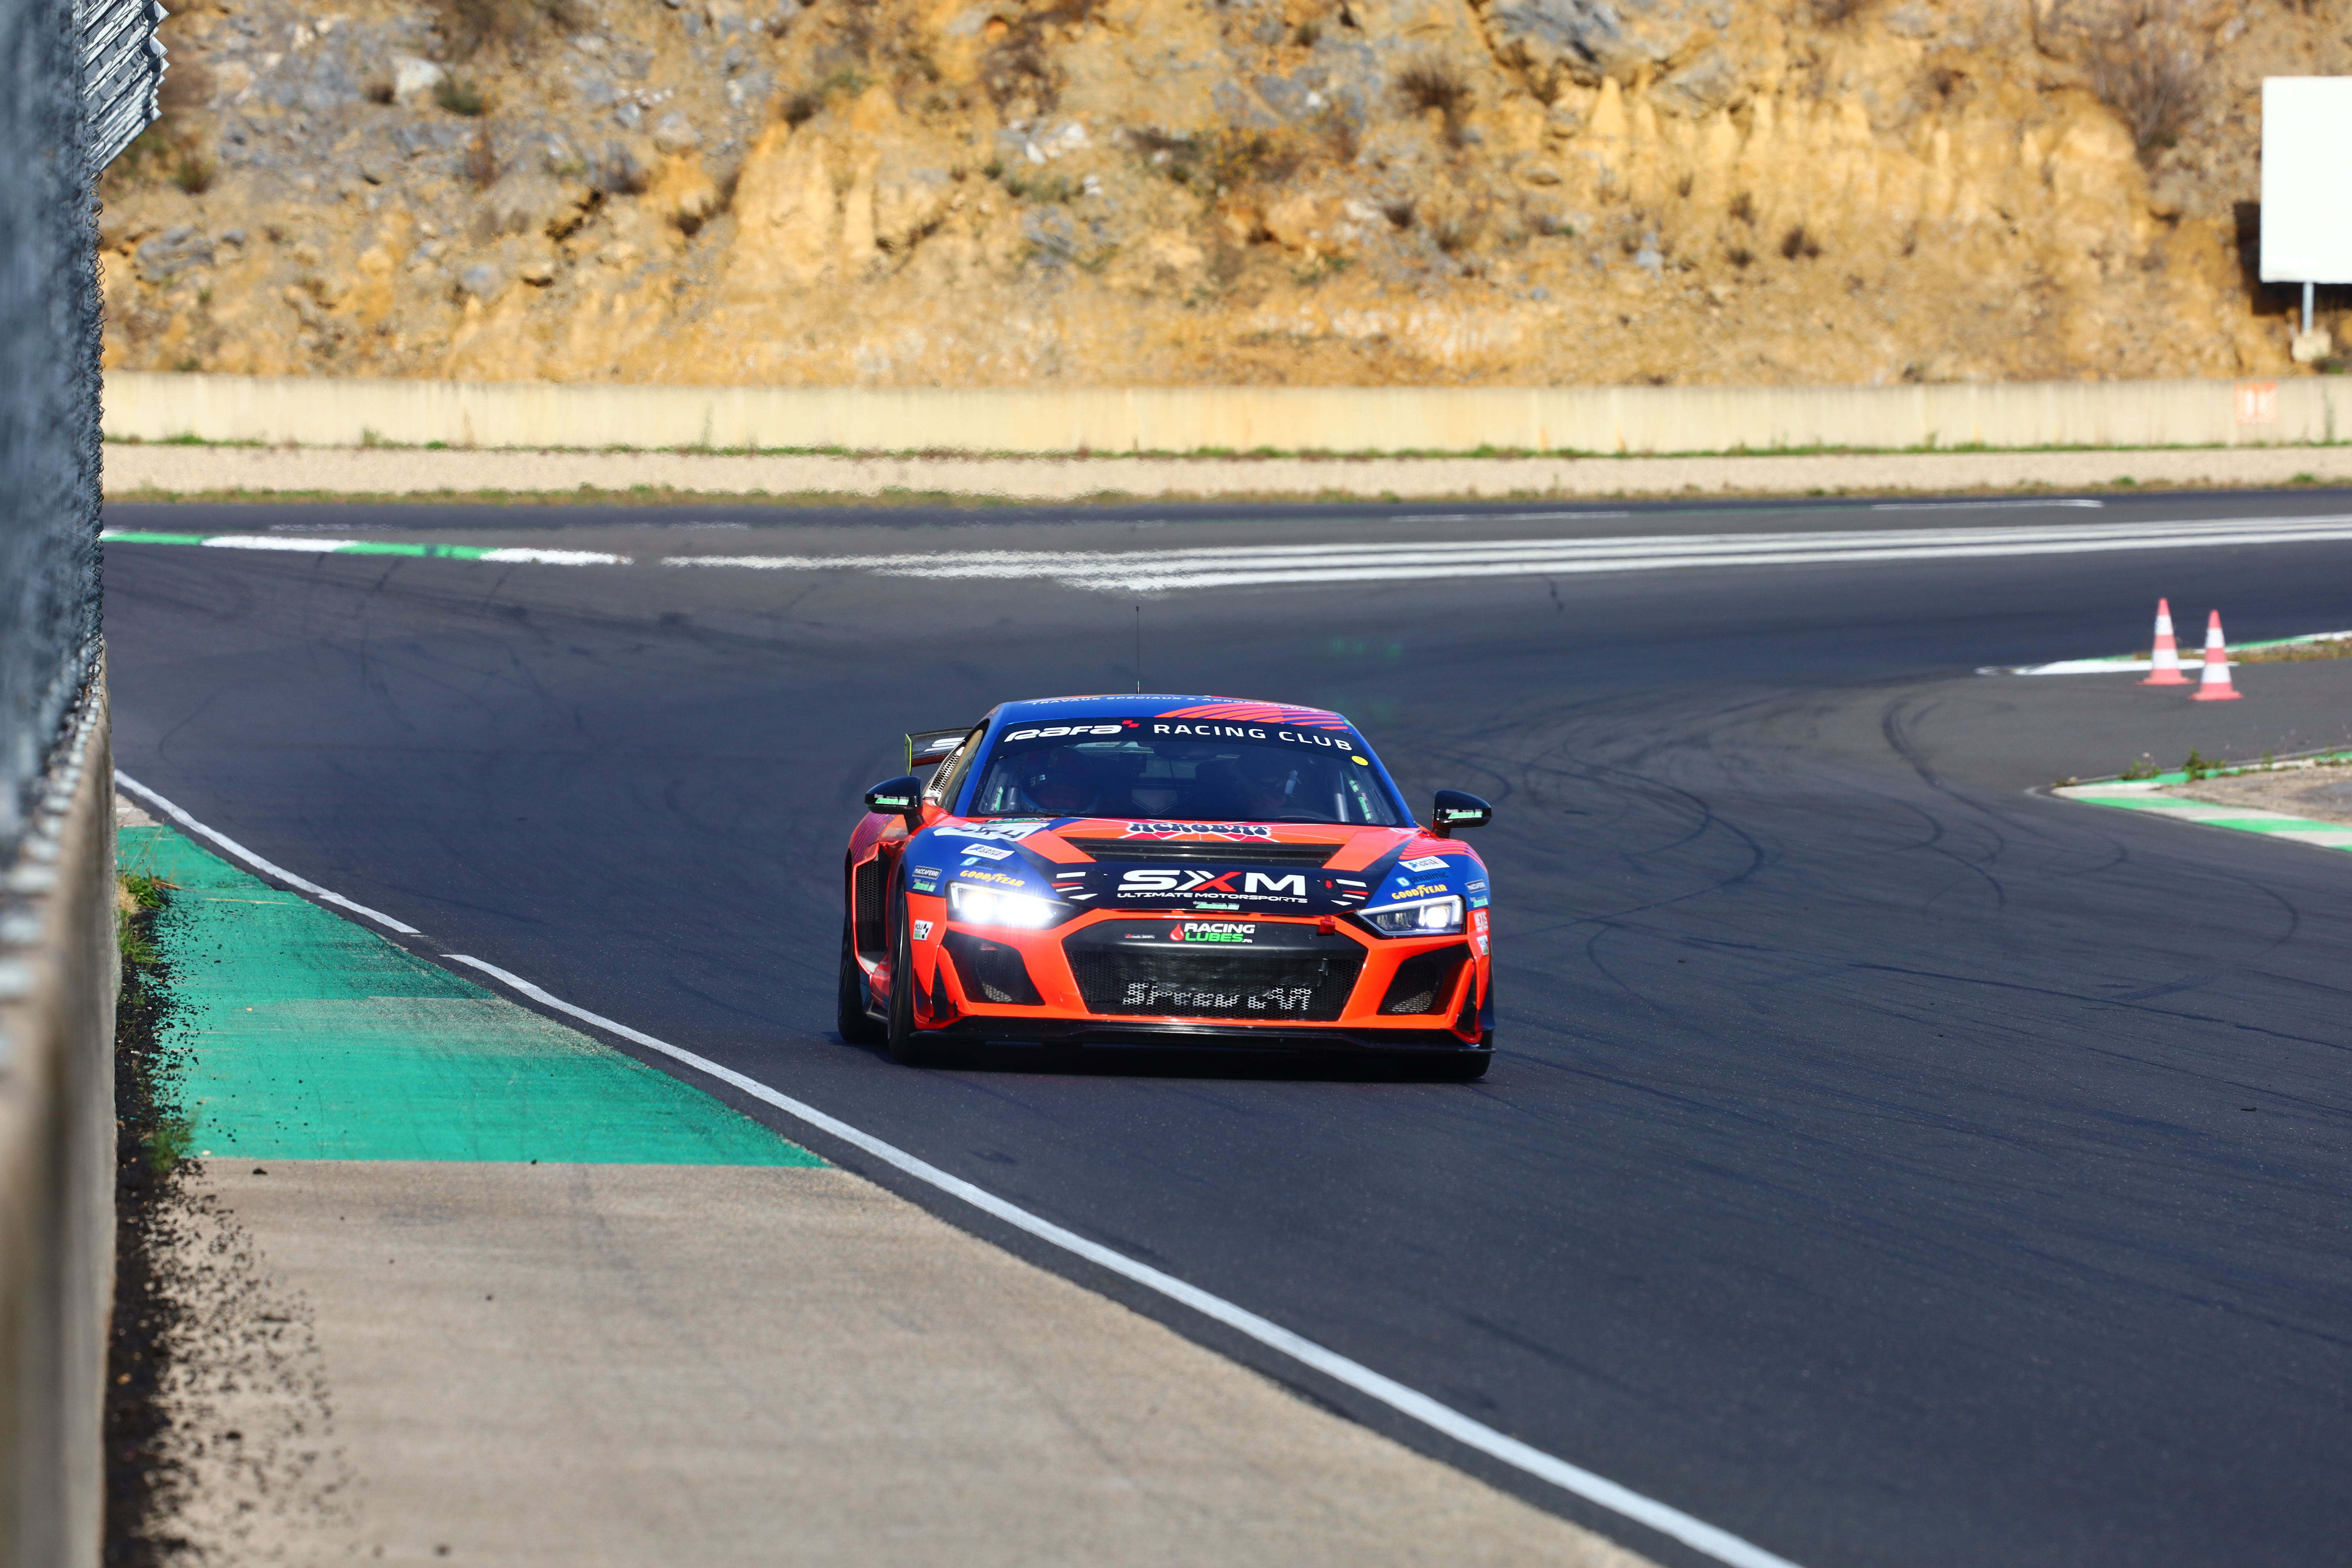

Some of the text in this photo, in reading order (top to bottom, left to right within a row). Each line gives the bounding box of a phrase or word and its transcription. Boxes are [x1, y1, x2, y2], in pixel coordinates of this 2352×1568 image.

[1154, 724, 1266, 739] RACING
[1279, 731, 1352, 751] CLUB
[1127, 822, 1271, 836] ACROBAT
[914, 868, 939, 877] MACCAFERRI
[960, 870, 1025, 887] GOODYEAR
[1118, 870, 1306, 896] SXM
[1194, 893, 1308, 903] MOTORSPORTS
[1391, 884, 1448, 899] GOODYEAR
[1184, 923, 1255, 934] RACING
